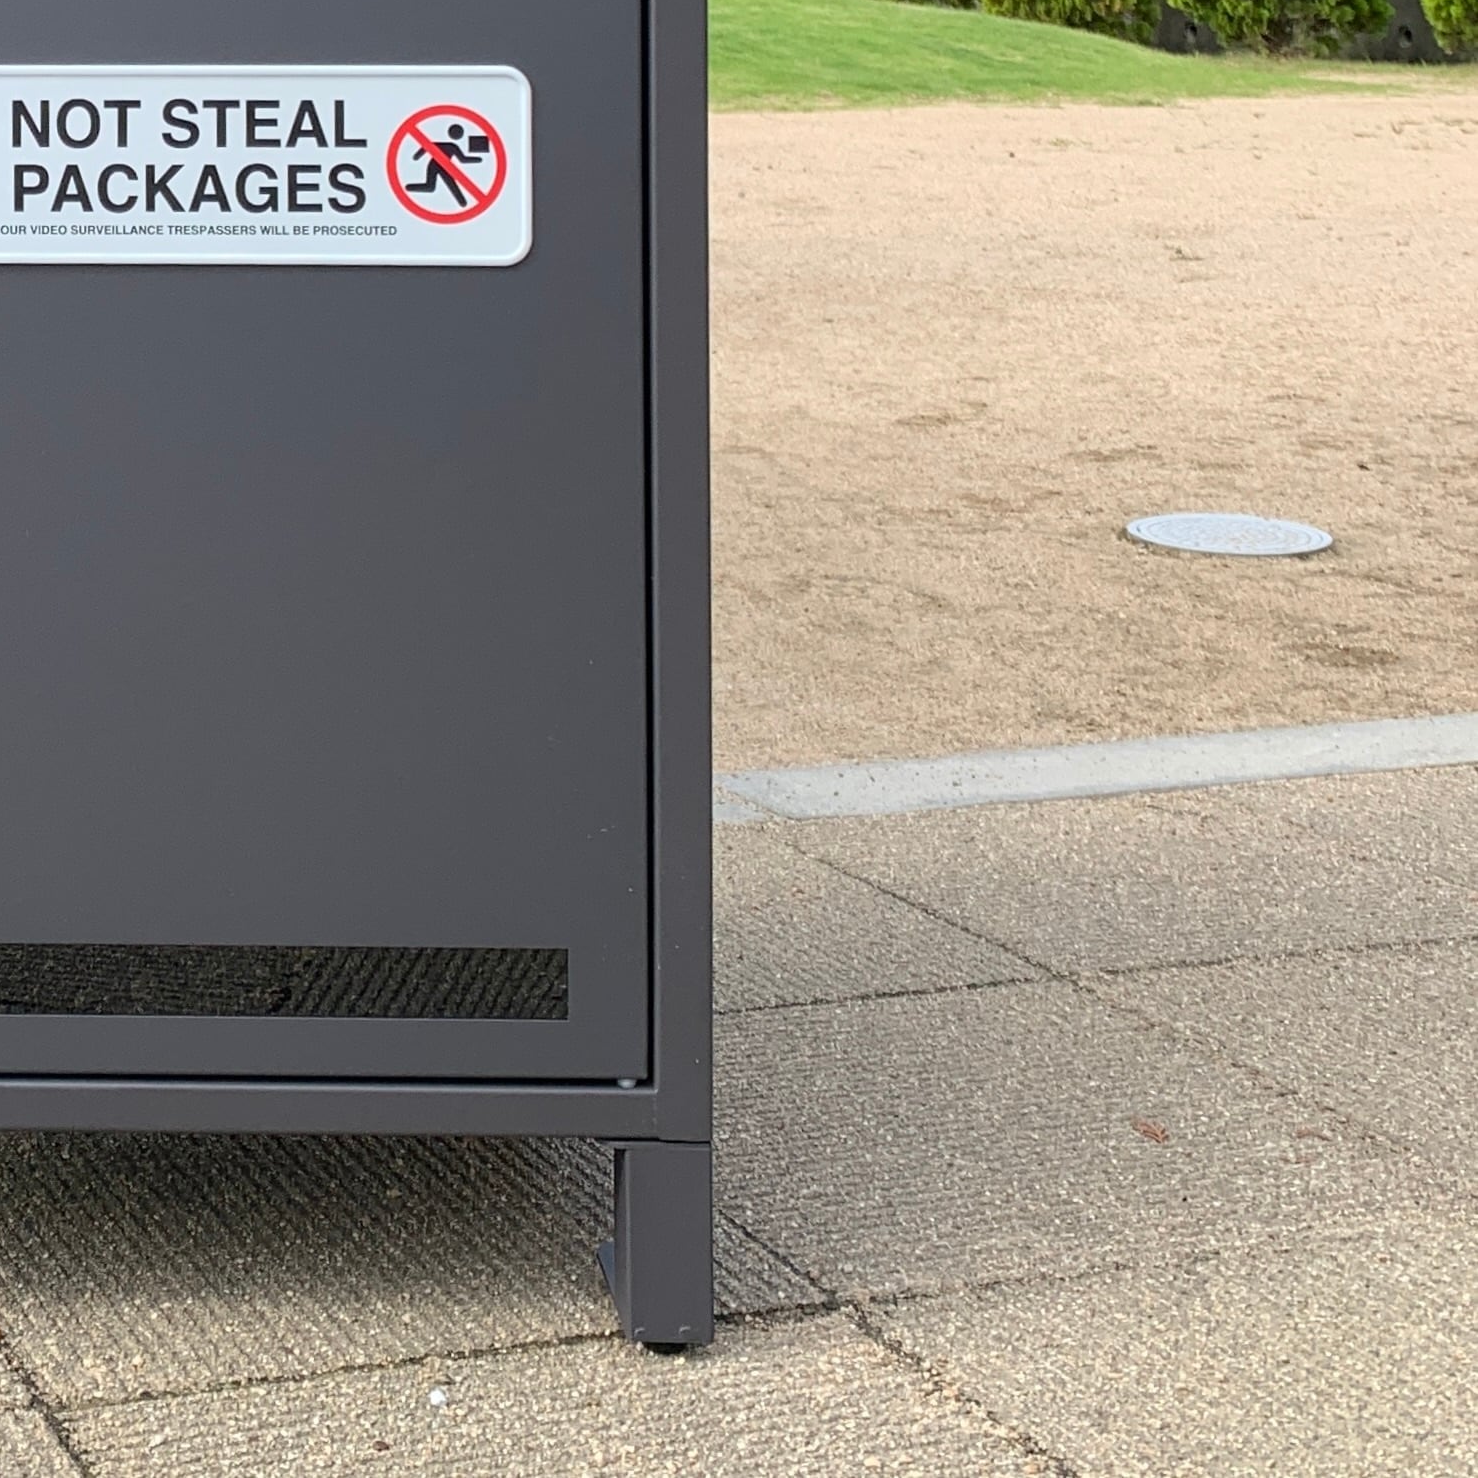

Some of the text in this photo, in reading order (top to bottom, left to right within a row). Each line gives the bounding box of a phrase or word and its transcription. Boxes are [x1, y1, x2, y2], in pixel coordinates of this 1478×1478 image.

[12, 99, 143, 149] NOT
[161, 99, 369, 149] STEAL
[13, 164, 367, 214] PACKAGES
[30, 225, 68, 236] VIDEO
[70, 225, 164, 236] SURVEILLANCE
[167, 225, 257, 236] TRESPASSERS
[259, 225, 290, 236] WILL
[292, 225, 310, 236] BE
[313, 225, 398, 236] PROSECUTED
